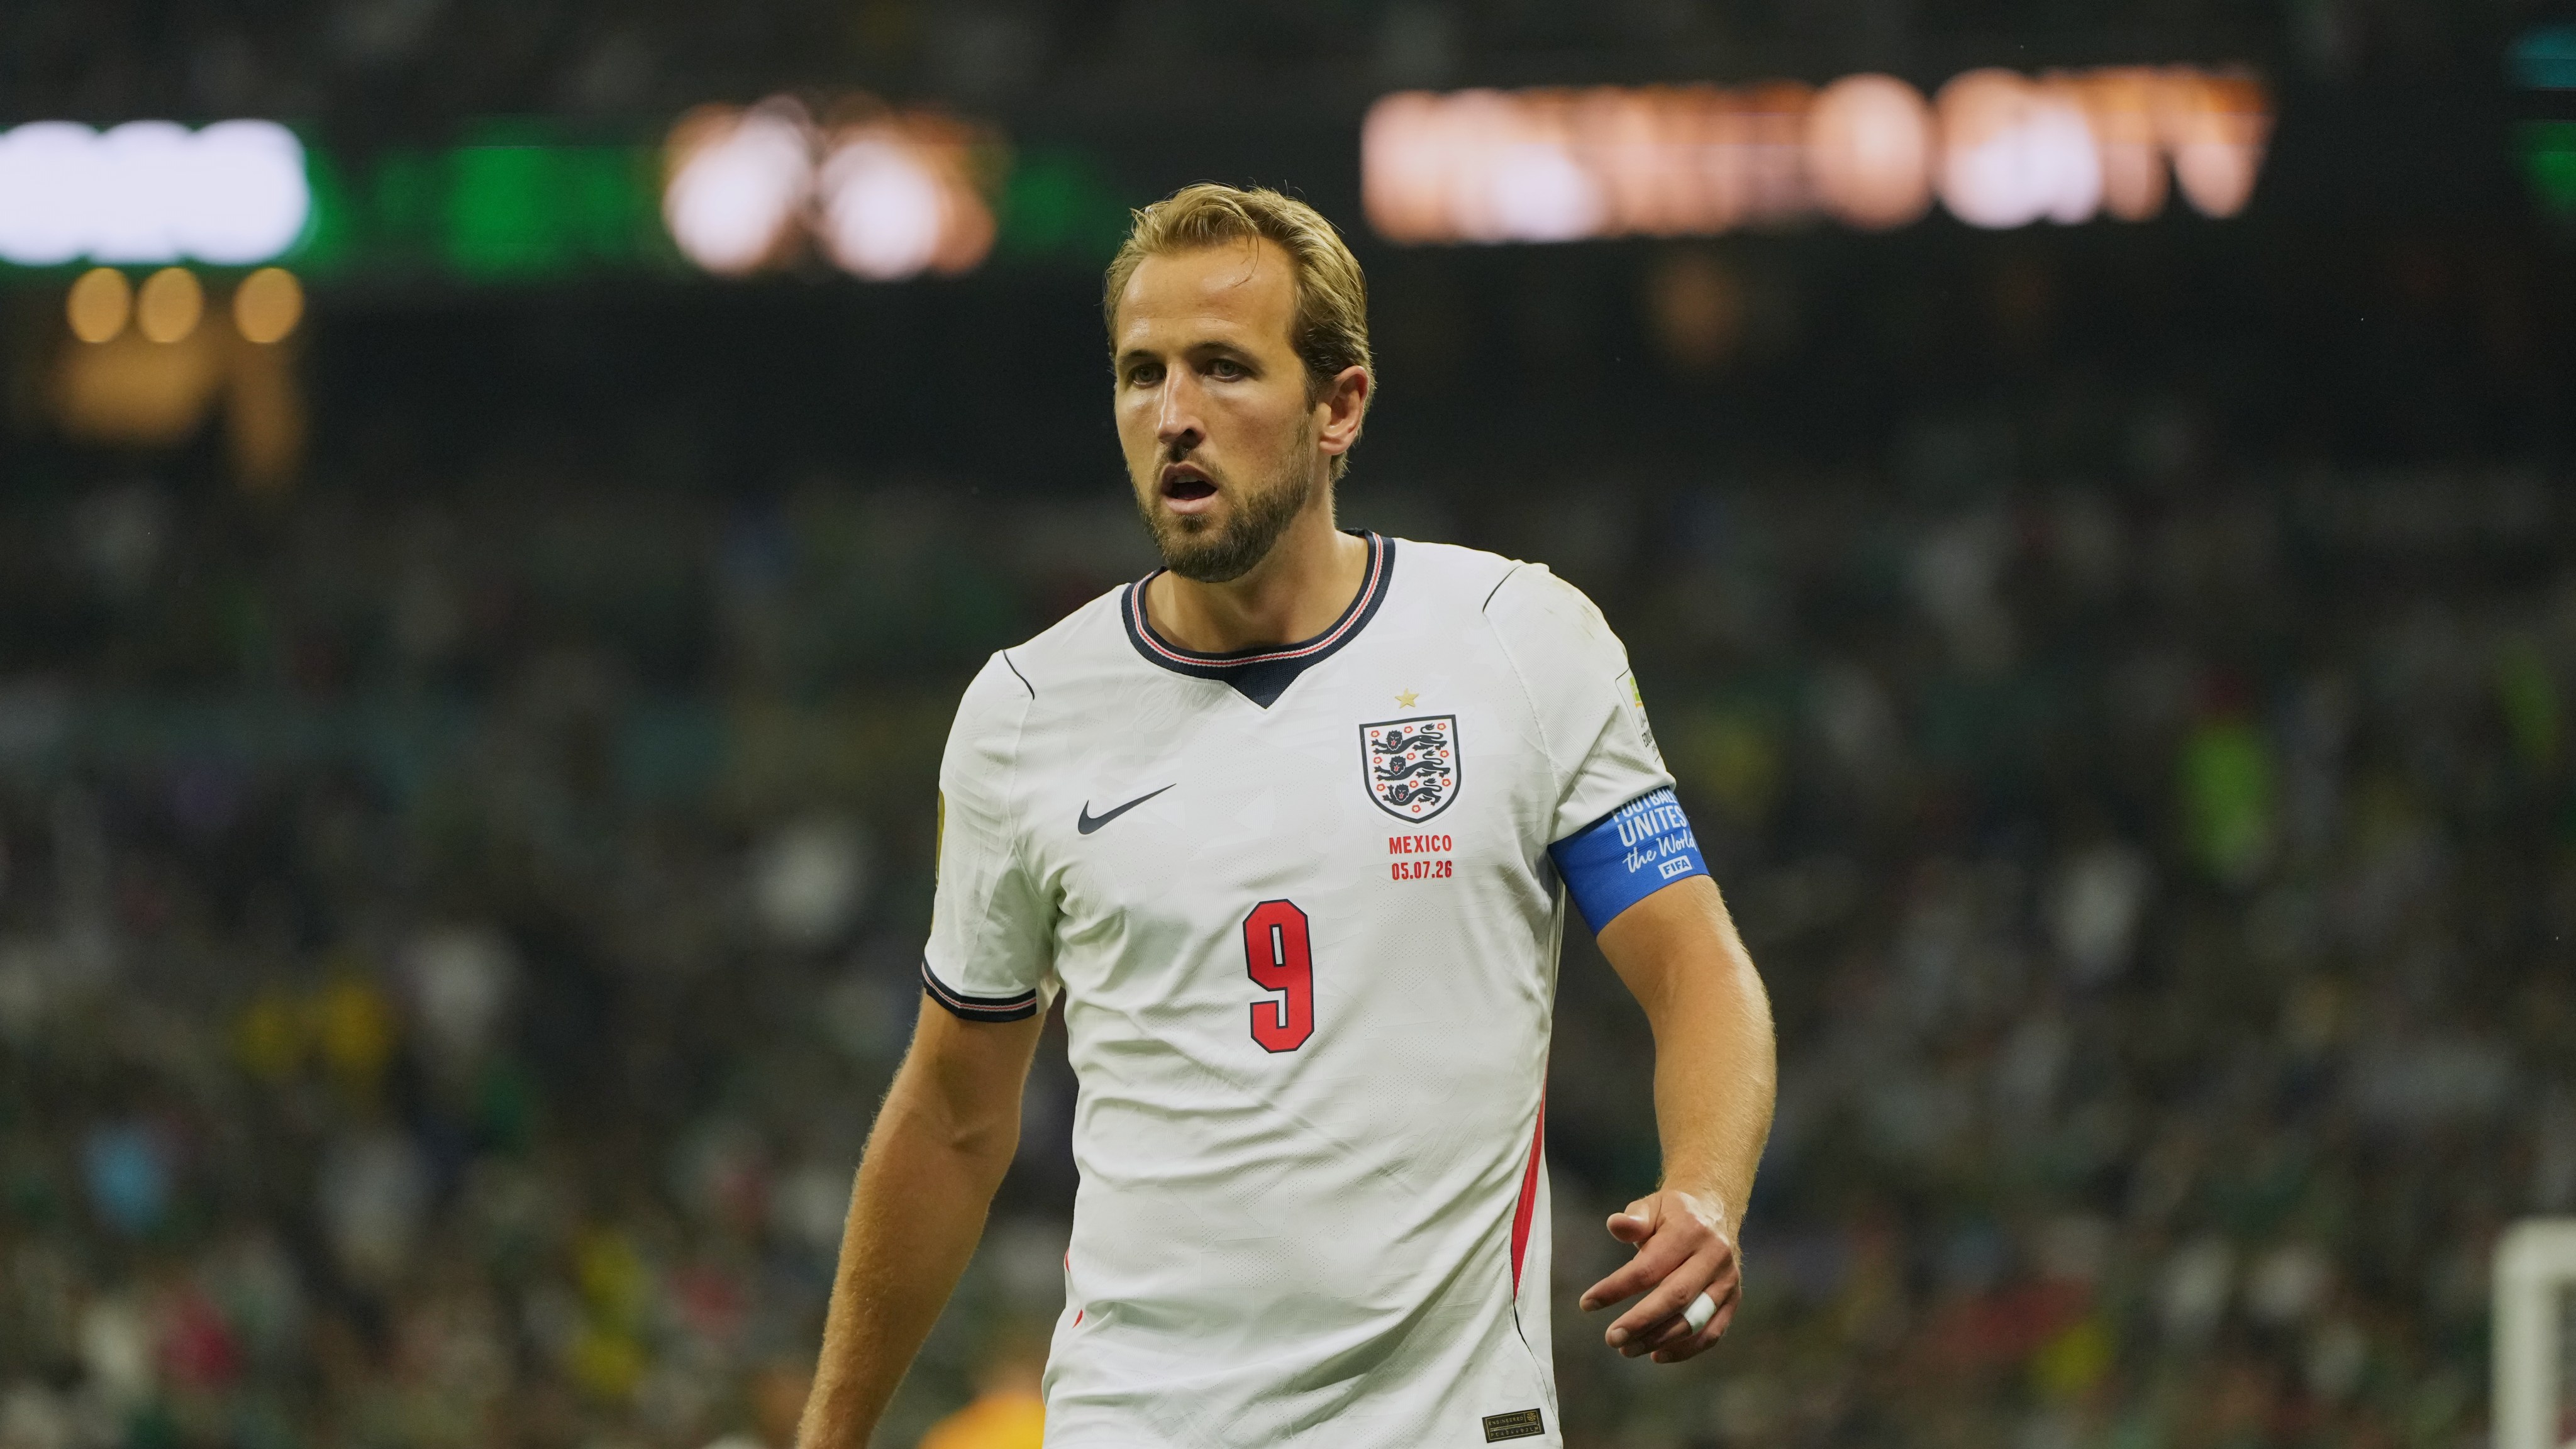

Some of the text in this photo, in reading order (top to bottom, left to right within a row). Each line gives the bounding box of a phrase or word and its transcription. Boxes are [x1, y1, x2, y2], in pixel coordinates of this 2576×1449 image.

[1618, 805, 1687, 847] UNITES
[1389, 835, 1452, 854] MEXICO
[1623, 829, 1697, 873] the World
[1392, 860, 1452, 880] 05.07.26
[1663, 860, 1689, 875] FIFA
[1243, 899, 1314, 1053] 9
[1488, 1416, 1523, 1425] ENGINEERED
